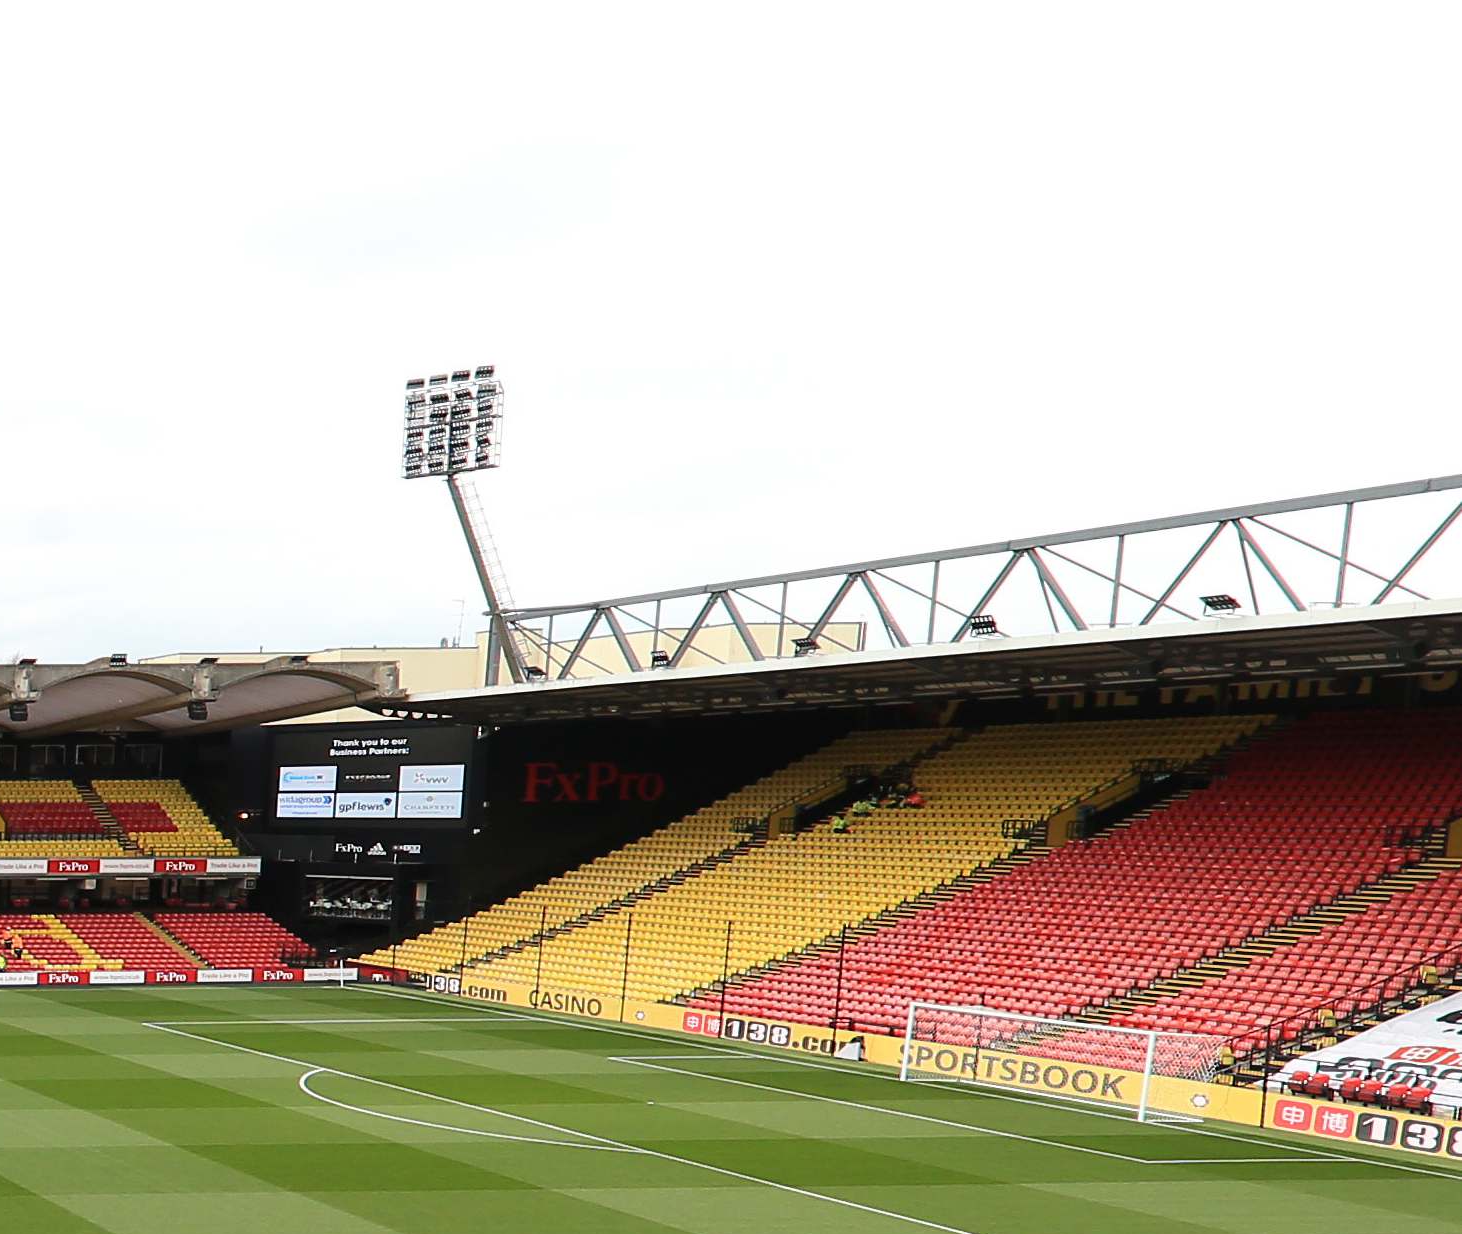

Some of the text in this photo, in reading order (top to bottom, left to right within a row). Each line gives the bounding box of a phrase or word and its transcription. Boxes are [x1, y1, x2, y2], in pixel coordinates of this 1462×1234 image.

[330, 748, 366, 756] Business
[522, 762, 666, 803] FxPro
[336, 843, 363, 853] FxPro
[59, 862, 90, 872] FxPro
[166, 862, 196, 871] FxPro
[48, 973, 79, 983] FxPro
[156, 971, 186, 981] FxPro
[264, 970, 294, 980] FxPro
[529, 989, 602, 1017] CASINO
[899, 1044, 1126, 1099] SPORTSBOOK
[1281, 1105, 1349, 1134] 申博
